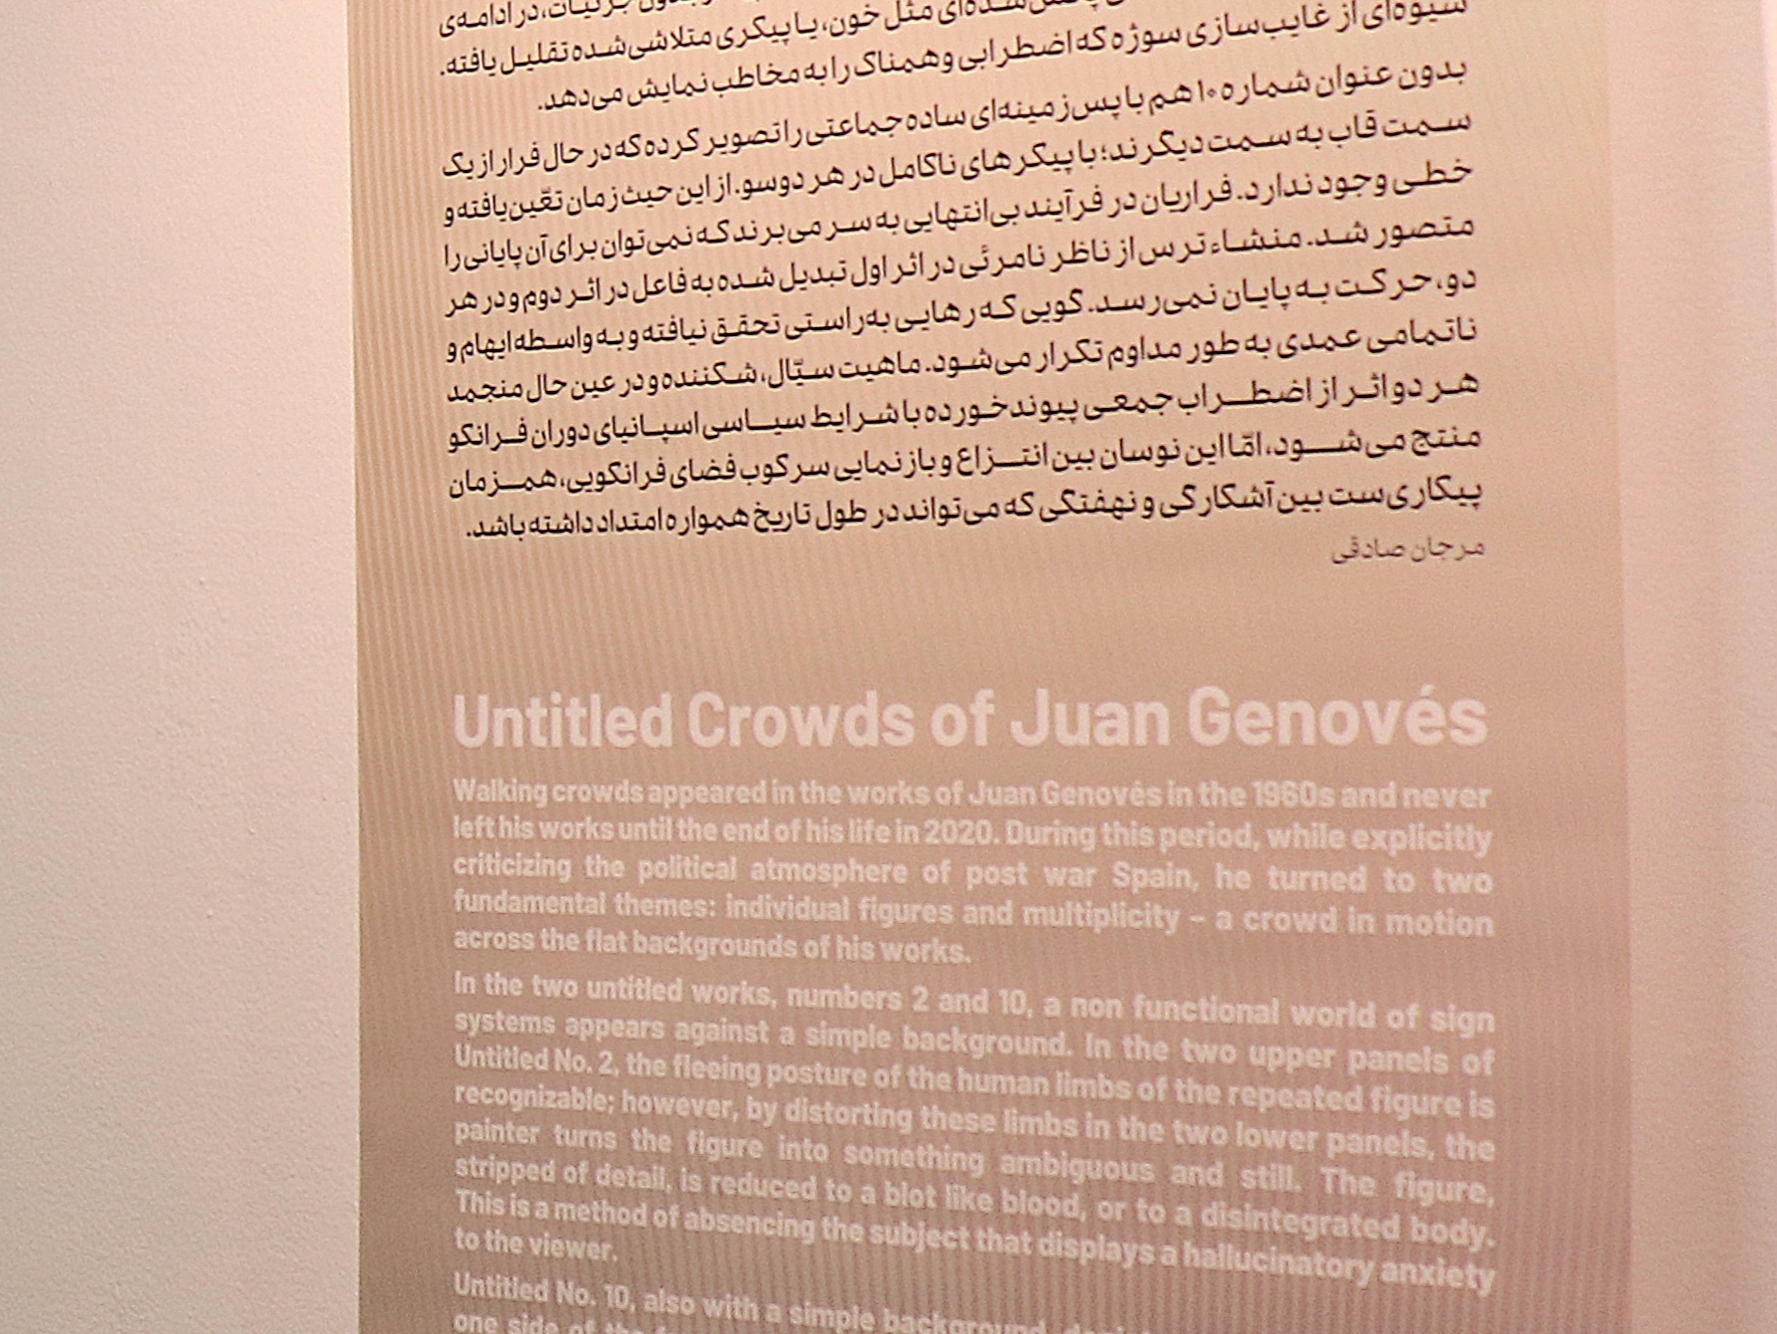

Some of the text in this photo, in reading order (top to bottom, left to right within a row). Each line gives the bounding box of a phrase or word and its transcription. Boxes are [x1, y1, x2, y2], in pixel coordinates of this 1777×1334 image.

[815, 498, 868, 531] طول
[871, 502, 899, 529] در
[903, 495, 1000, 527] می‌تواند
[1004, 490, 1035, 517] که
[1038, 487, 1137, 523] نهفتگی
[1141, 495, 1155, 519] و
[1159, 479, 1275, 519] آشکارگی
[1276, 489, 1324, 514] بین
[529, 509, 593, 534] داشته
[596, 505, 663, 533] امتداد
[665, 504, 750, 537] همواره
[753, 500, 811, 533] تاریخ
[1331, 535, 1485, 565] مرجان صادقی
[455, 688, 1488, 747] Untitled Crowds of Juan Genovés
[453, 776, 547, 810] Walking
[552, 777, 643, 803] crowds
[649, 778, 767, 811] appeared
[772, 778, 795, 804] in
[800, 778, 842, 805] the
[848, 779, 930, 805] works
[936, 779, 963, 805] of
[969, 779, 1036, 806] Juan
[1168, 780, 1192, 806] in
[1199, 781, 1246, 807] the
[1251, 781, 1334, 807] 1960s
[1342, 781, 1396, 807] and
[1403, 788, 1492, 808] never
[453, 812, 495, 838] left
[499, 813, 534, 839] his
[539, 814, 614, 840] works
[619, 814, 672, 841] until
[677, 815, 717, 841] the
[723, 816, 769, 842] end
[775, 816, 800, 842] of
[806, 816, 844, 843] his
[849, 817, 890, 843] life
[896, 818, 919, 844] in
[925, 818, 999, 844] 2020.
[1006, 819, 1095, 852] During
[1102, 819, 1154, 846] this
[1267, 821, 1345, 848] while
[1352, 822, 1493, 856] explicitly
[454, 848, 571, 883] criticizing
[585, 851, 624, 877] the
[639, 852, 737, 885] political
[752, 855, 908, 889] atmosphere
[923, 858, 950, 884] of
[967, 859, 1027, 891] post
[1044, 866, 1096, 886] war
[1216, 863, 1251, 889] he
[1268, 863, 1366, 891] turned
[1384, 865, 1415, 892] to
[1434, 866, 1494, 893] two
[454, 886, 606, 916] fundamental
[615, 890, 716, 918] themes:
[727, 893, 849, 922] individual
[859, 896, 953, 930] figures
[963, 899, 1013, 925] and
[1023, 900, 1180, 936] multiplicity
[1216, 910, 1233, 930] a
[1244, 906, 1337, 932] crowd
[1348, 907, 1375, 933] in
[1387, 909, 1496, 936] motion
[454, 925, 971, 963] across the flat backgrounds of his works.
[455, 968, 476, 995] In
[484, 969, 523, 996] the
[532, 971, 578, 998] two
[587, 974, 682, 1002] untitled
[787, 982, 902, 1010] numbers
[913, 985, 929, 1011] 2
[939, 987, 989, 1013] and
[1044, 996, 1061, 1016] a
[1071, 997, 1123, 1018] non
[1134, 993, 1279, 1024] functional
[1291, 1001, 1375, 1028] world
[1387, 1003, 1418, 1029] of
[1431, 1005, 1495, 1038] sign
[454, 1270, 549, 1302] Untitled
[644, 1288, 695, 1315] also
[704, 1293, 758, 1320] with
[766, 1303, 782, 1322] a
[790, 1301, 874, 1334] simple
